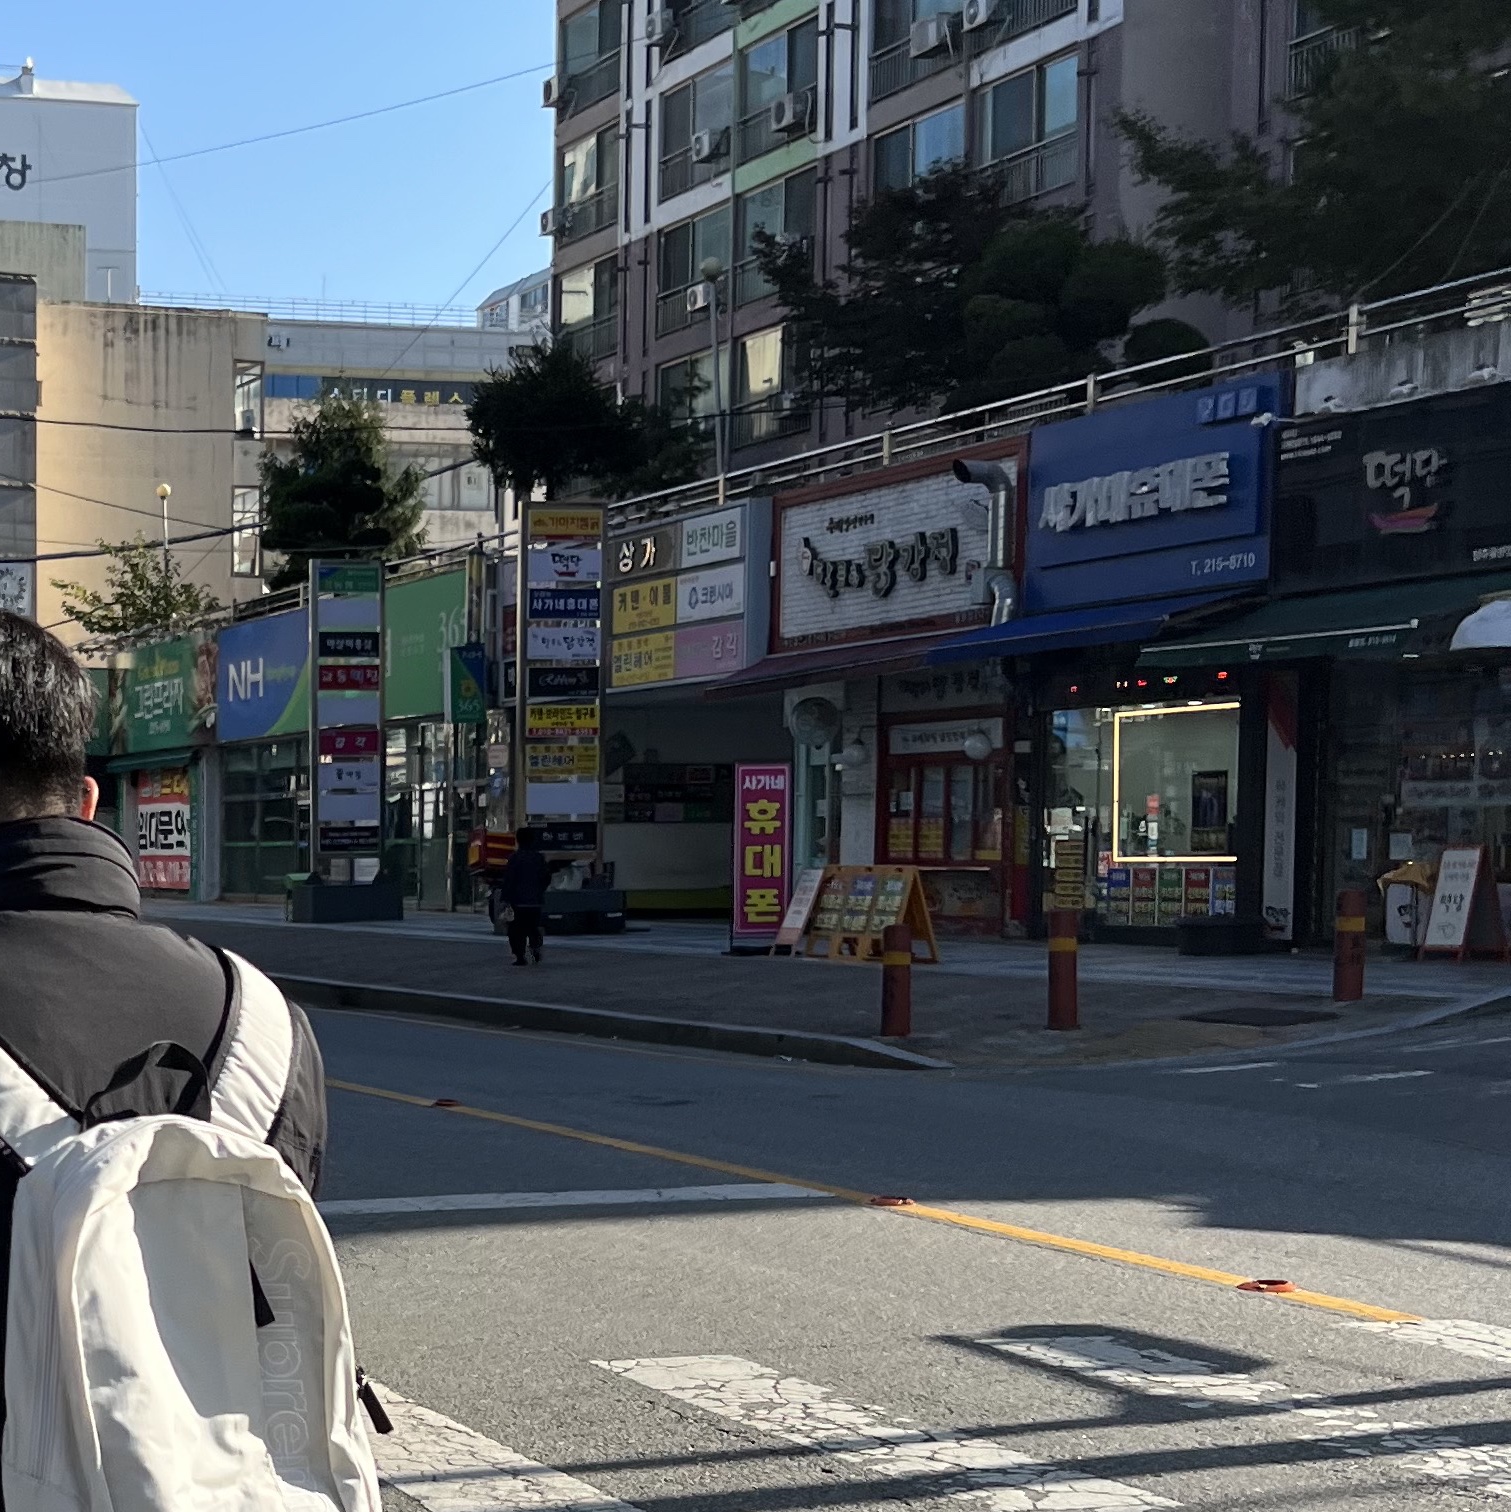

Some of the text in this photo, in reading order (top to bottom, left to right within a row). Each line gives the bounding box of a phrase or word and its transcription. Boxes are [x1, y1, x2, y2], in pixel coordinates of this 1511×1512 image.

[619, 535, 657, 574] 상가
[686, 519, 738, 557] 반찬마을
[228, 657, 264, 703] NH
[743, 798, 782, 924] 휴대폰
